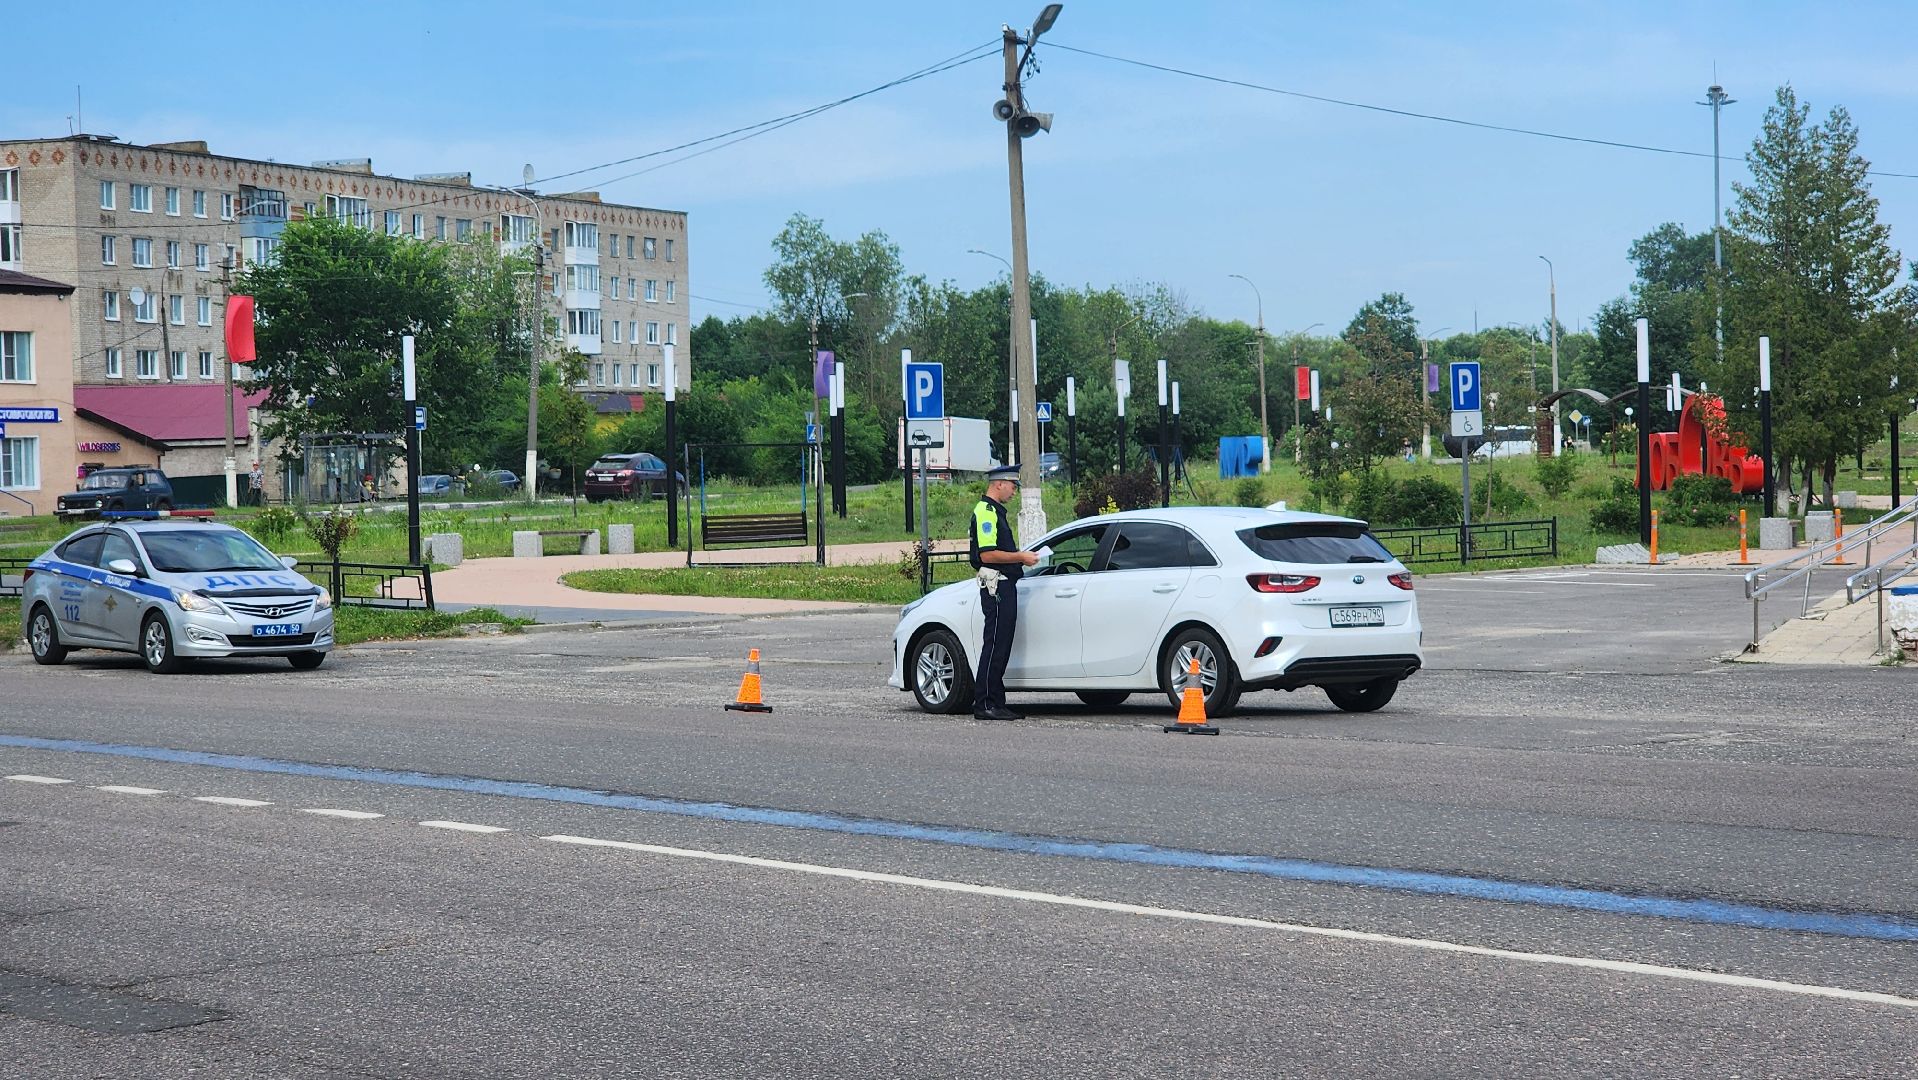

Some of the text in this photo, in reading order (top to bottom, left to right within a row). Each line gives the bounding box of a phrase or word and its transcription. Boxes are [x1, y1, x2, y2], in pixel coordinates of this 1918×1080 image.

[915, 370, 934, 413] P
[1458, 368, 1473, 406] P
[204, 574, 297, 589] ДПС
[64, 604, 80, 621] 112
[265, 624, 287, 635] 4674
